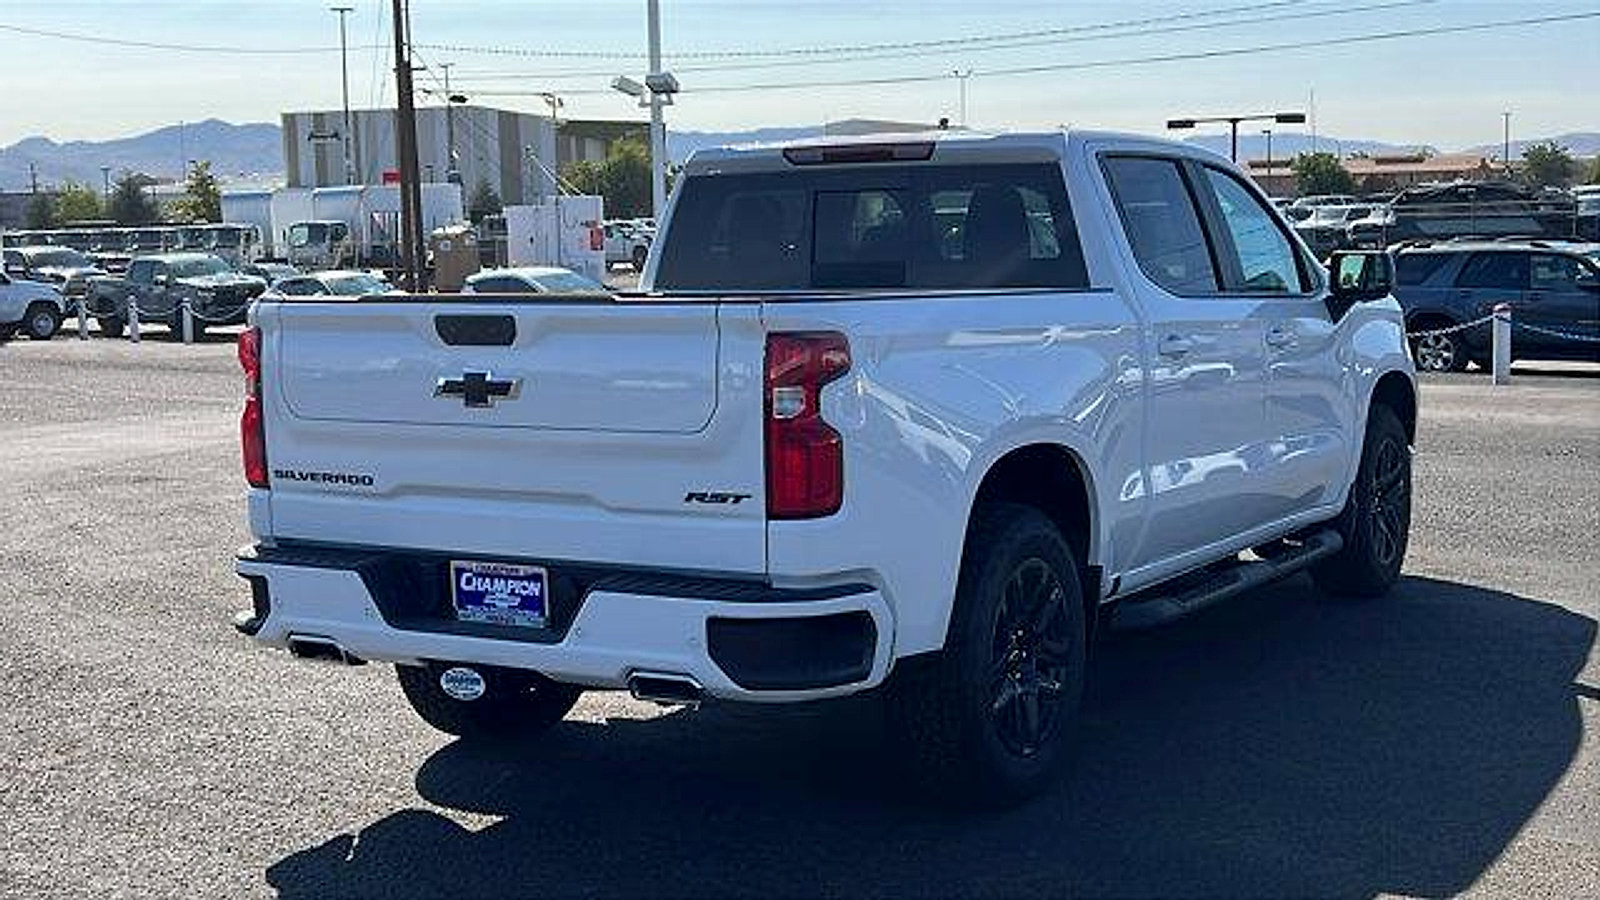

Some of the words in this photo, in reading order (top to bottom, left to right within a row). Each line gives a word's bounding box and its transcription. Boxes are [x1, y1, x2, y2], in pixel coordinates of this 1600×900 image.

[274, 469, 374, 486] SILVERADO
[684, 492, 753, 504] RST
[460, 573, 541, 596] CHAMPION
